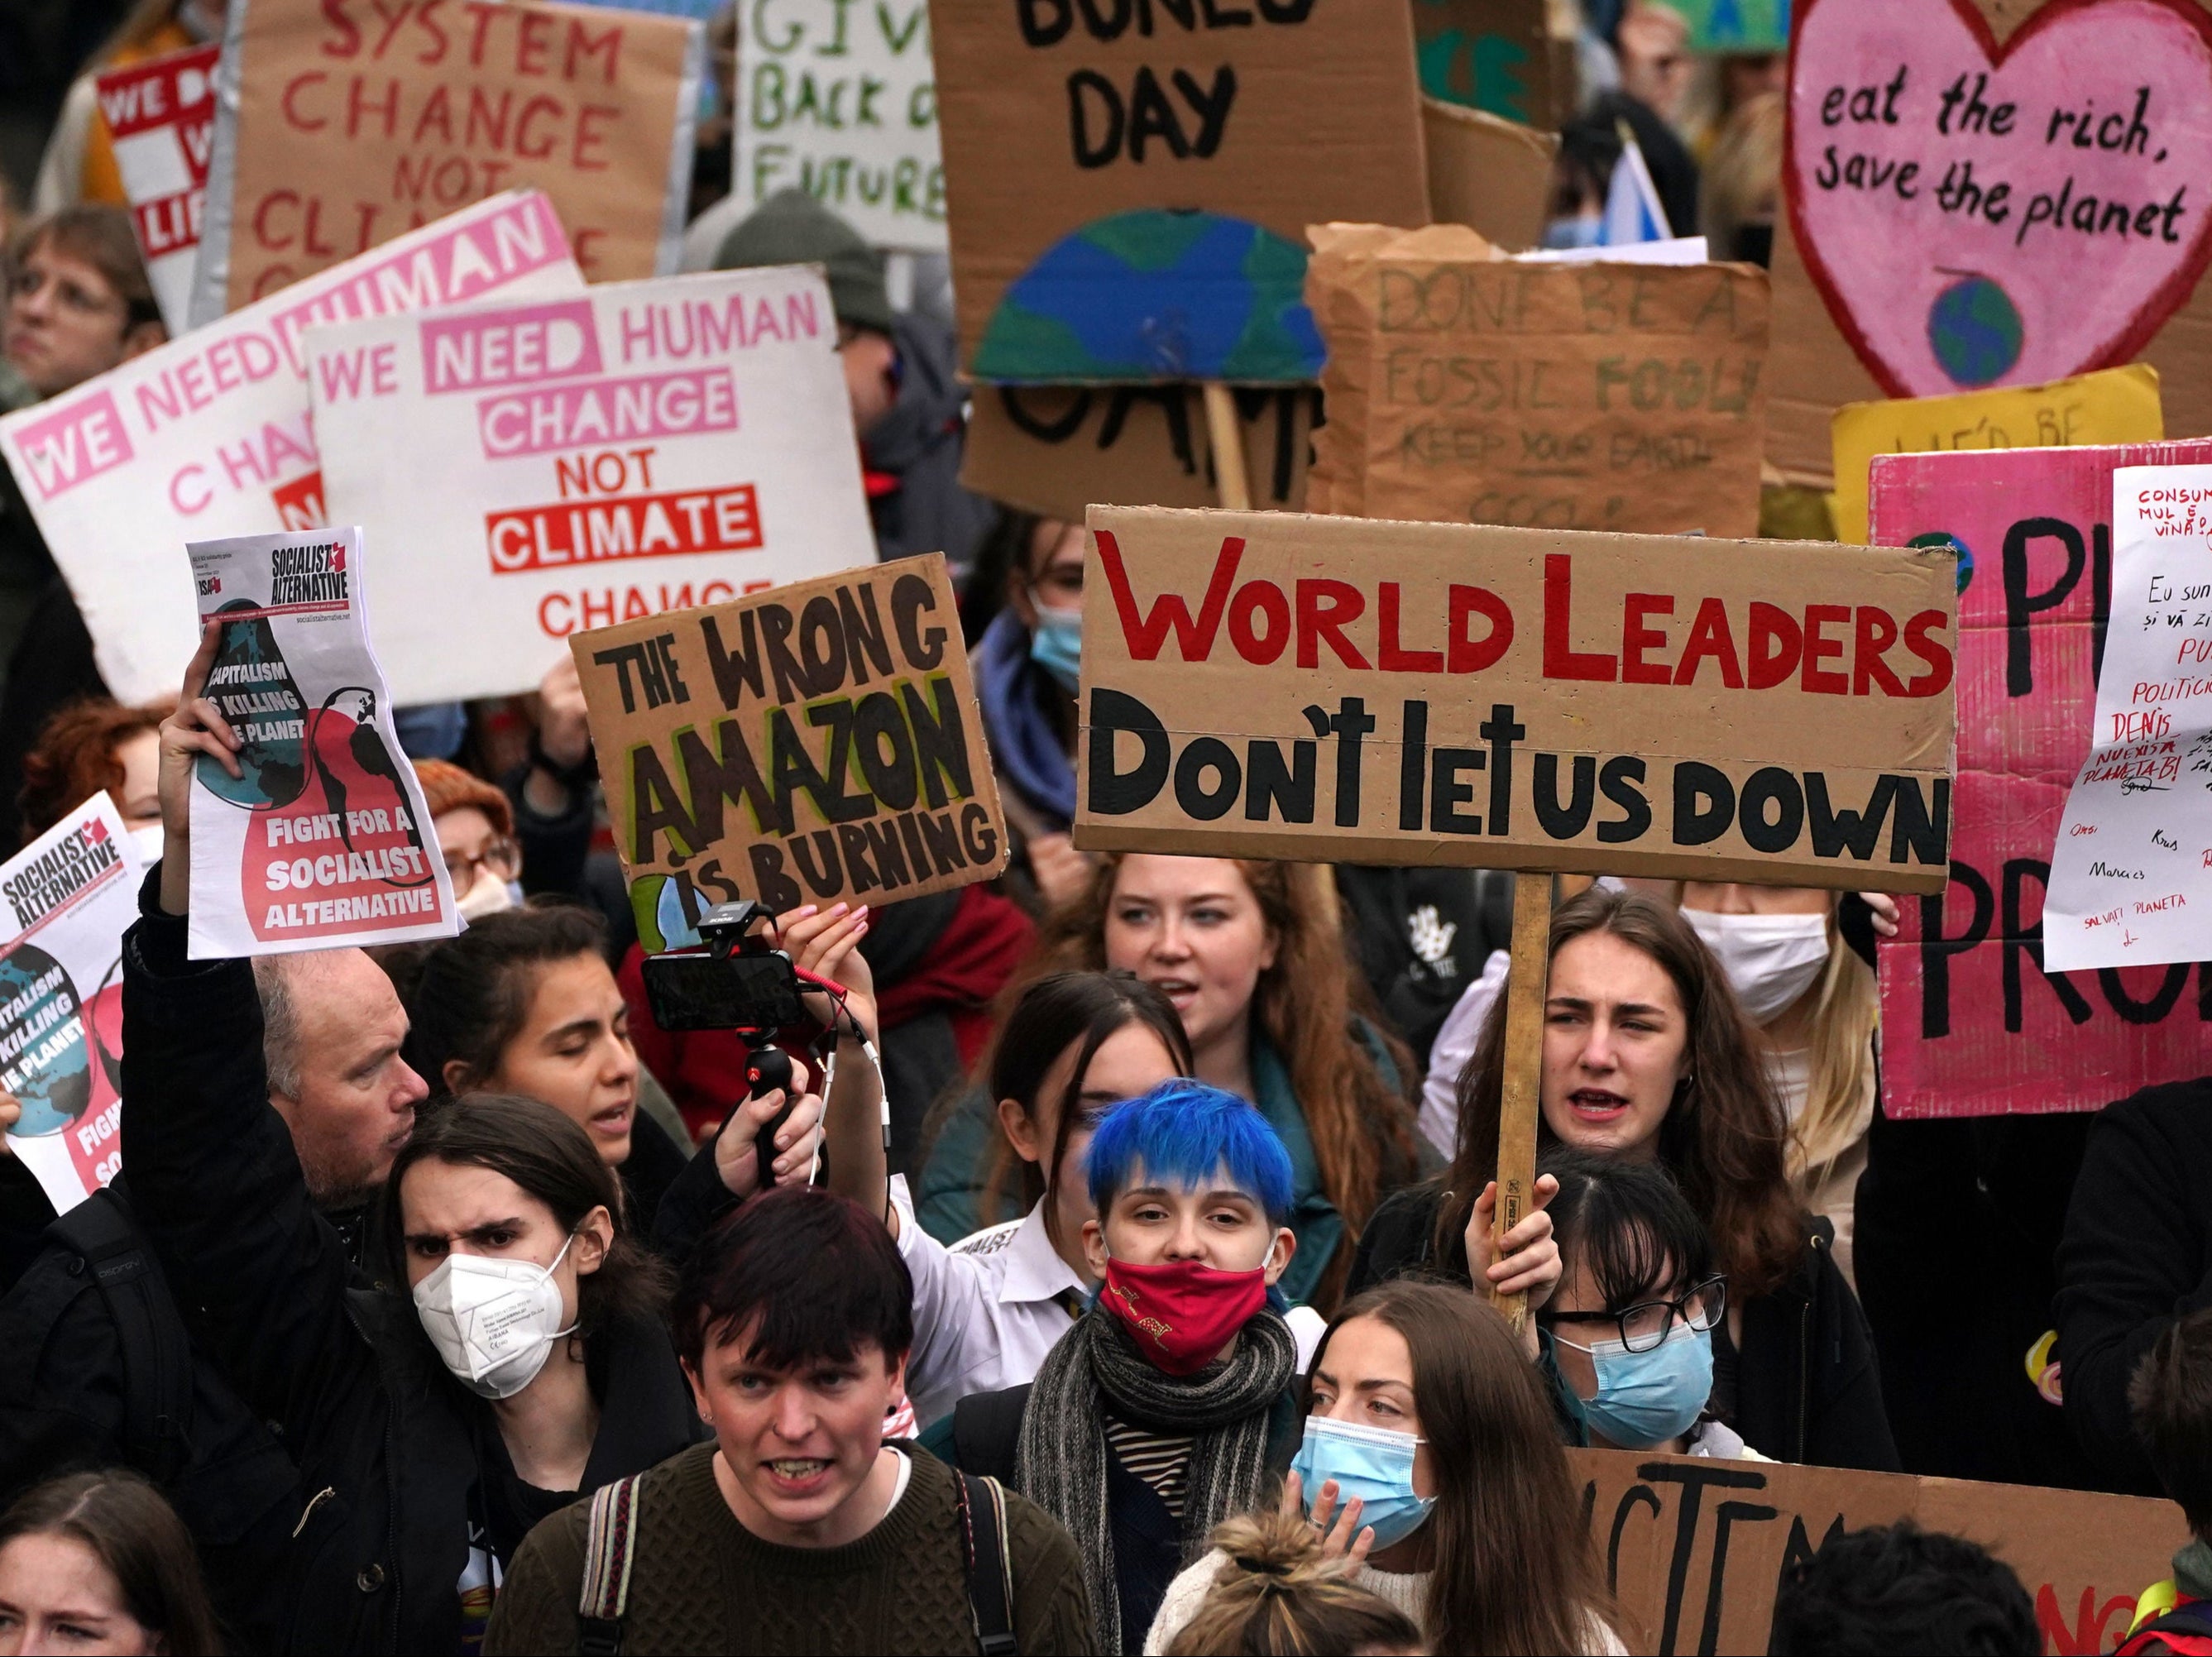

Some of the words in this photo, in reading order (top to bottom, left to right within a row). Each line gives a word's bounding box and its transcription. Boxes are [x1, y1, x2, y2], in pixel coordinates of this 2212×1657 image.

[320, 0, 624, 84] SYSTEM
[751, 0, 930, 59] GIV
[282, 71, 624, 170] CHANGE
[751, 61, 886, 131] BACK
[1066, 63, 1238, 169] DAY
[1821, 64, 1908, 126] eat
[1937, 72, 2018, 135] the
[2045, 86, 2169, 164] rich,
[393, 153, 511, 207] NOT
[1815, 145, 1920, 200] save
[1935, 160, 2012, 225] the
[2015, 175, 2189, 248] planet
[1580, 269, 1663, 333] BE
[1693, 273, 1739, 331] A
[318, 342, 398, 405] WE
[433, 317, 588, 388] NEED
[620, 290, 819, 362] HUMAN
[1385, 347, 1563, 413] FOSSIL
[24, 414, 120, 492] WE
[133, 330, 280, 433] NEED
[481, 374, 736, 457] CHANGE
[1402, 419, 1506, 468] KEEP
[168, 409, 322, 516] CHA
[555, 447, 657, 498] NOT
[491, 491, 756, 570] CLIMATE
[2138, 506, 2176, 520] MUL
[271, 544, 333, 578] SOCIALIST
[271, 571, 349, 606] ALTERNATIVE
[592, 631, 691, 715] THE
[701, 572, 949, 712] WRONG
[1092, 529, 1515, 674] WORLD
[1542, 553, 1956, 699] LEADERS
[2177, 638, 2212, 664] PU
[222, 690, 301, 716] KILLING
[246, 719, 305, 743] PLANET
[625, 669, 975, 866] AMAZON
[266, 813, 342, 848] FIGHT
[346, 807, 392, 836] FOR
[395, 806, 414, 831] A
[1532, 751, 1653, 845] US
[1672, 759, 1951, 866] DOWN
[2, 827, 89, 907] SOCIALIST
[15, 836, 121, 931] ALTERNATIVE
[265, 845, 424, 892] SOCIALIST
[747, 802, 998, 911] BURNING
[264, 887, 434, 929] ALTERNATIVE
[2133, 893, 2186, 914] PLANETA
[0, 992, 74, 1065] KILLING
[18, 1016, 86, 1080] PLANET
